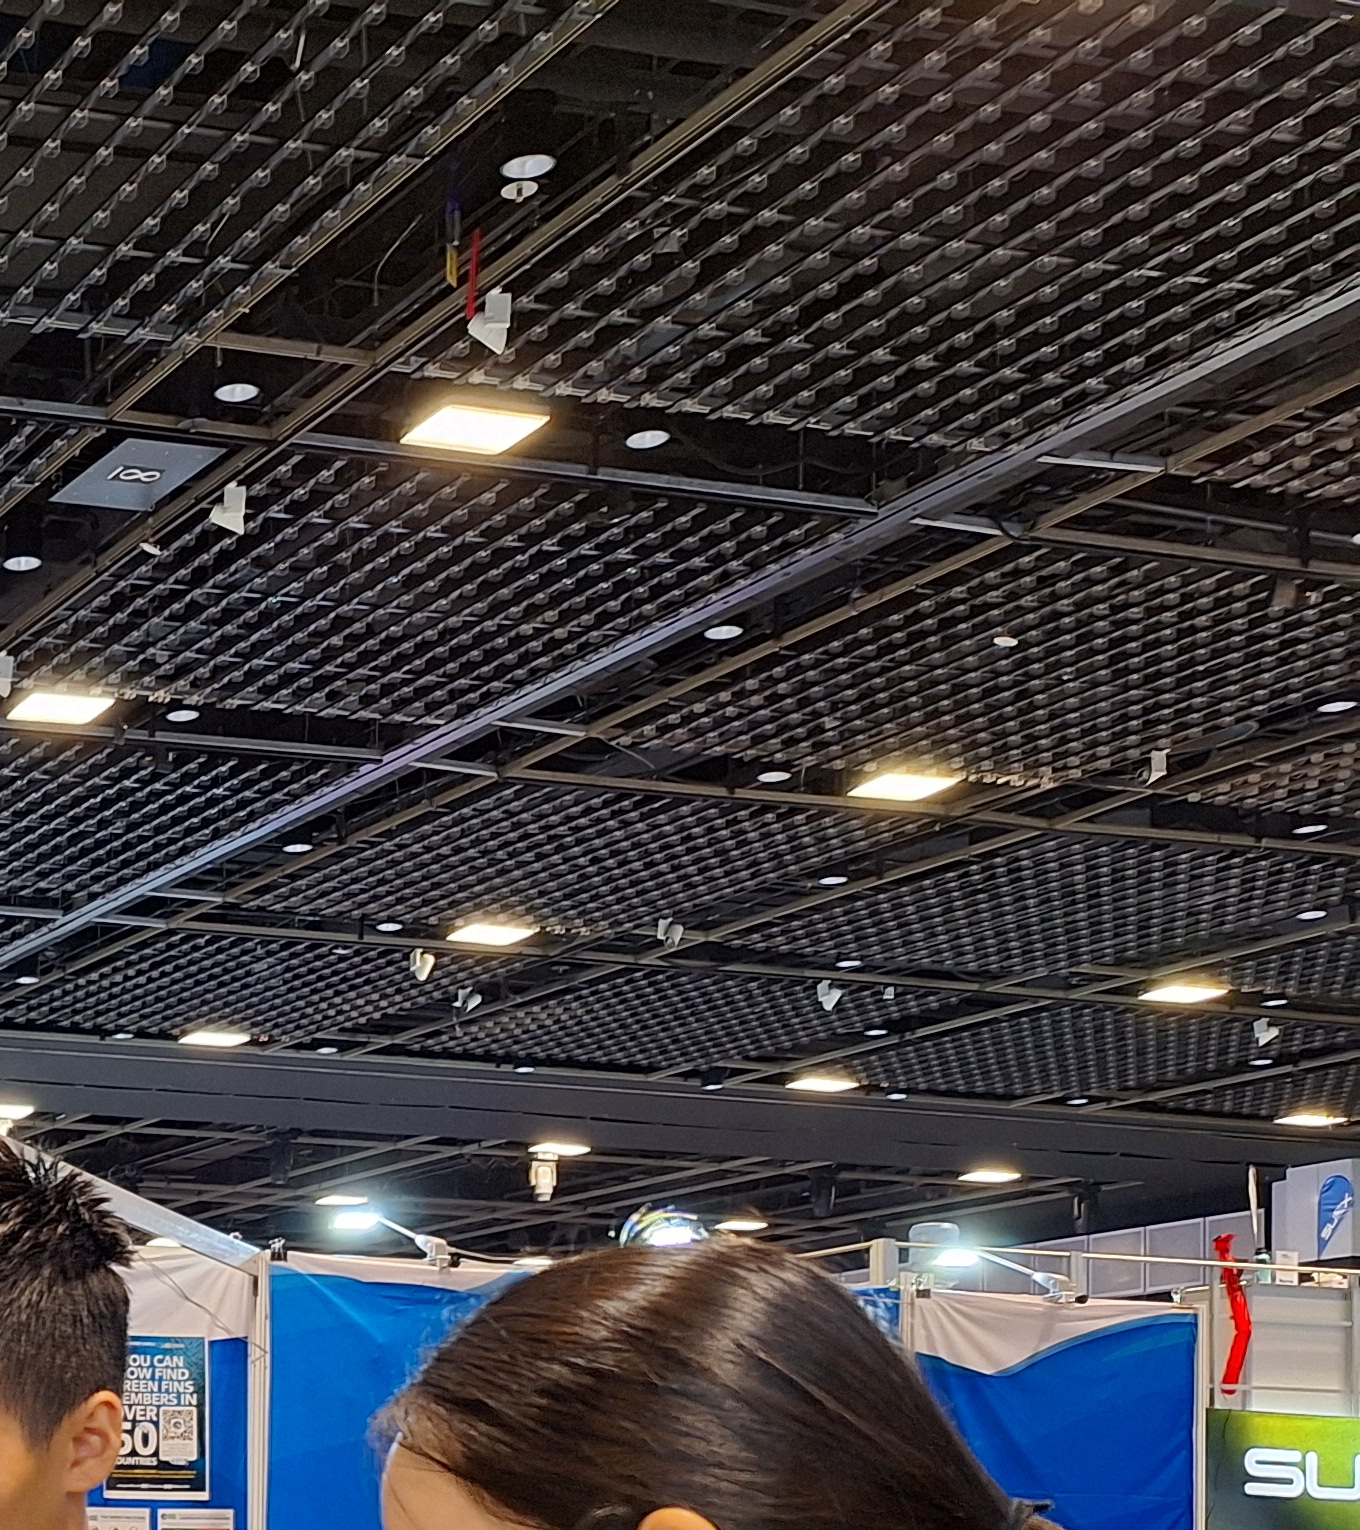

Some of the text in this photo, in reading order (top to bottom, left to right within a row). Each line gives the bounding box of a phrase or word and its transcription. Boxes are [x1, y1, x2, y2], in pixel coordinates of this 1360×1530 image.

[153, 1354, 184, 1368] CAN
[154, 1368, 190, 1381] FIND
[161, 1381, 194, 1394] FINS
[180, 1393, 197, 1406] IN
